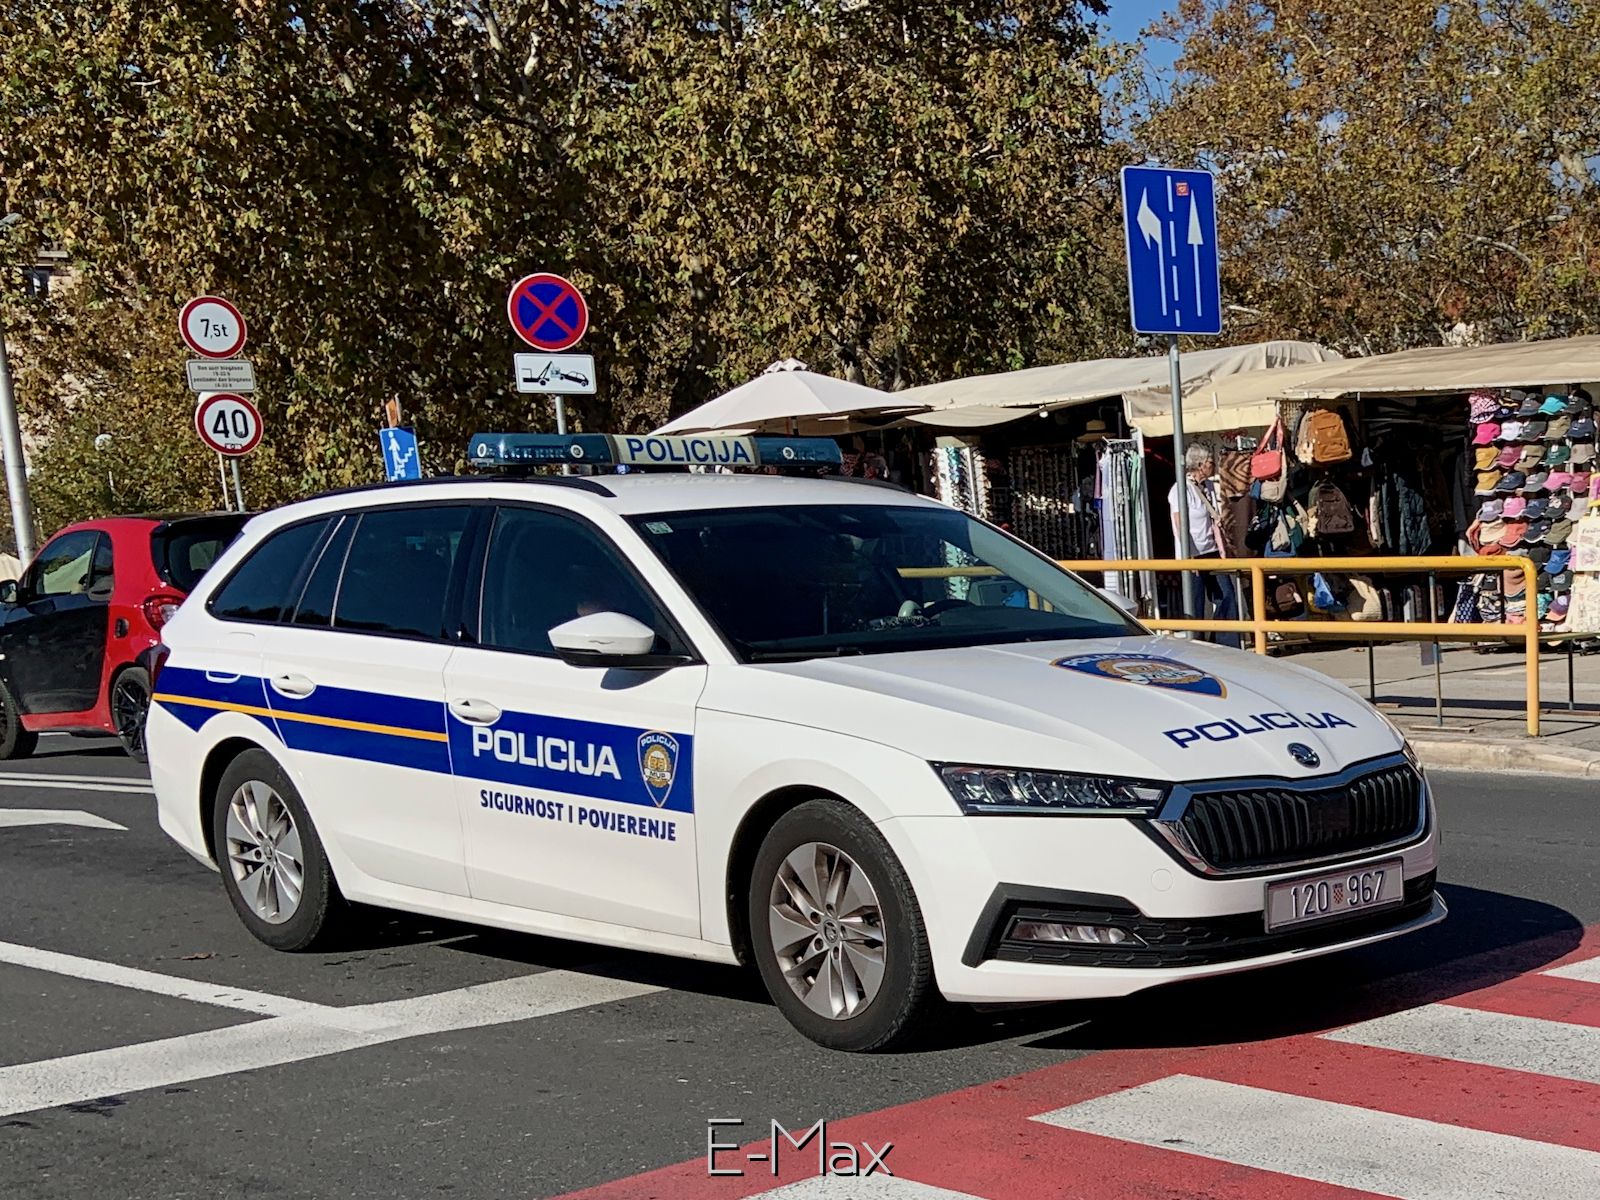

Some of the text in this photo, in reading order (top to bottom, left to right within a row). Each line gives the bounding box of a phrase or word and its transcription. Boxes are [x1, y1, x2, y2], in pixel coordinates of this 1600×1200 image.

[200, 318, 229, 339] 7,5t
[212, 409, 249, 438] 40
[625, 438, 751, 463] POLICIJA
[641, 735, 677, 753] POLICIJA
[1162, 712, 1357, 749] POLICIJA
[472, 725, 622, 780] POLICIJA
[480, 789, 677, 841] SIGURNOST I POVJERENJE
[1291, 870, 1385, 918] 120 967
